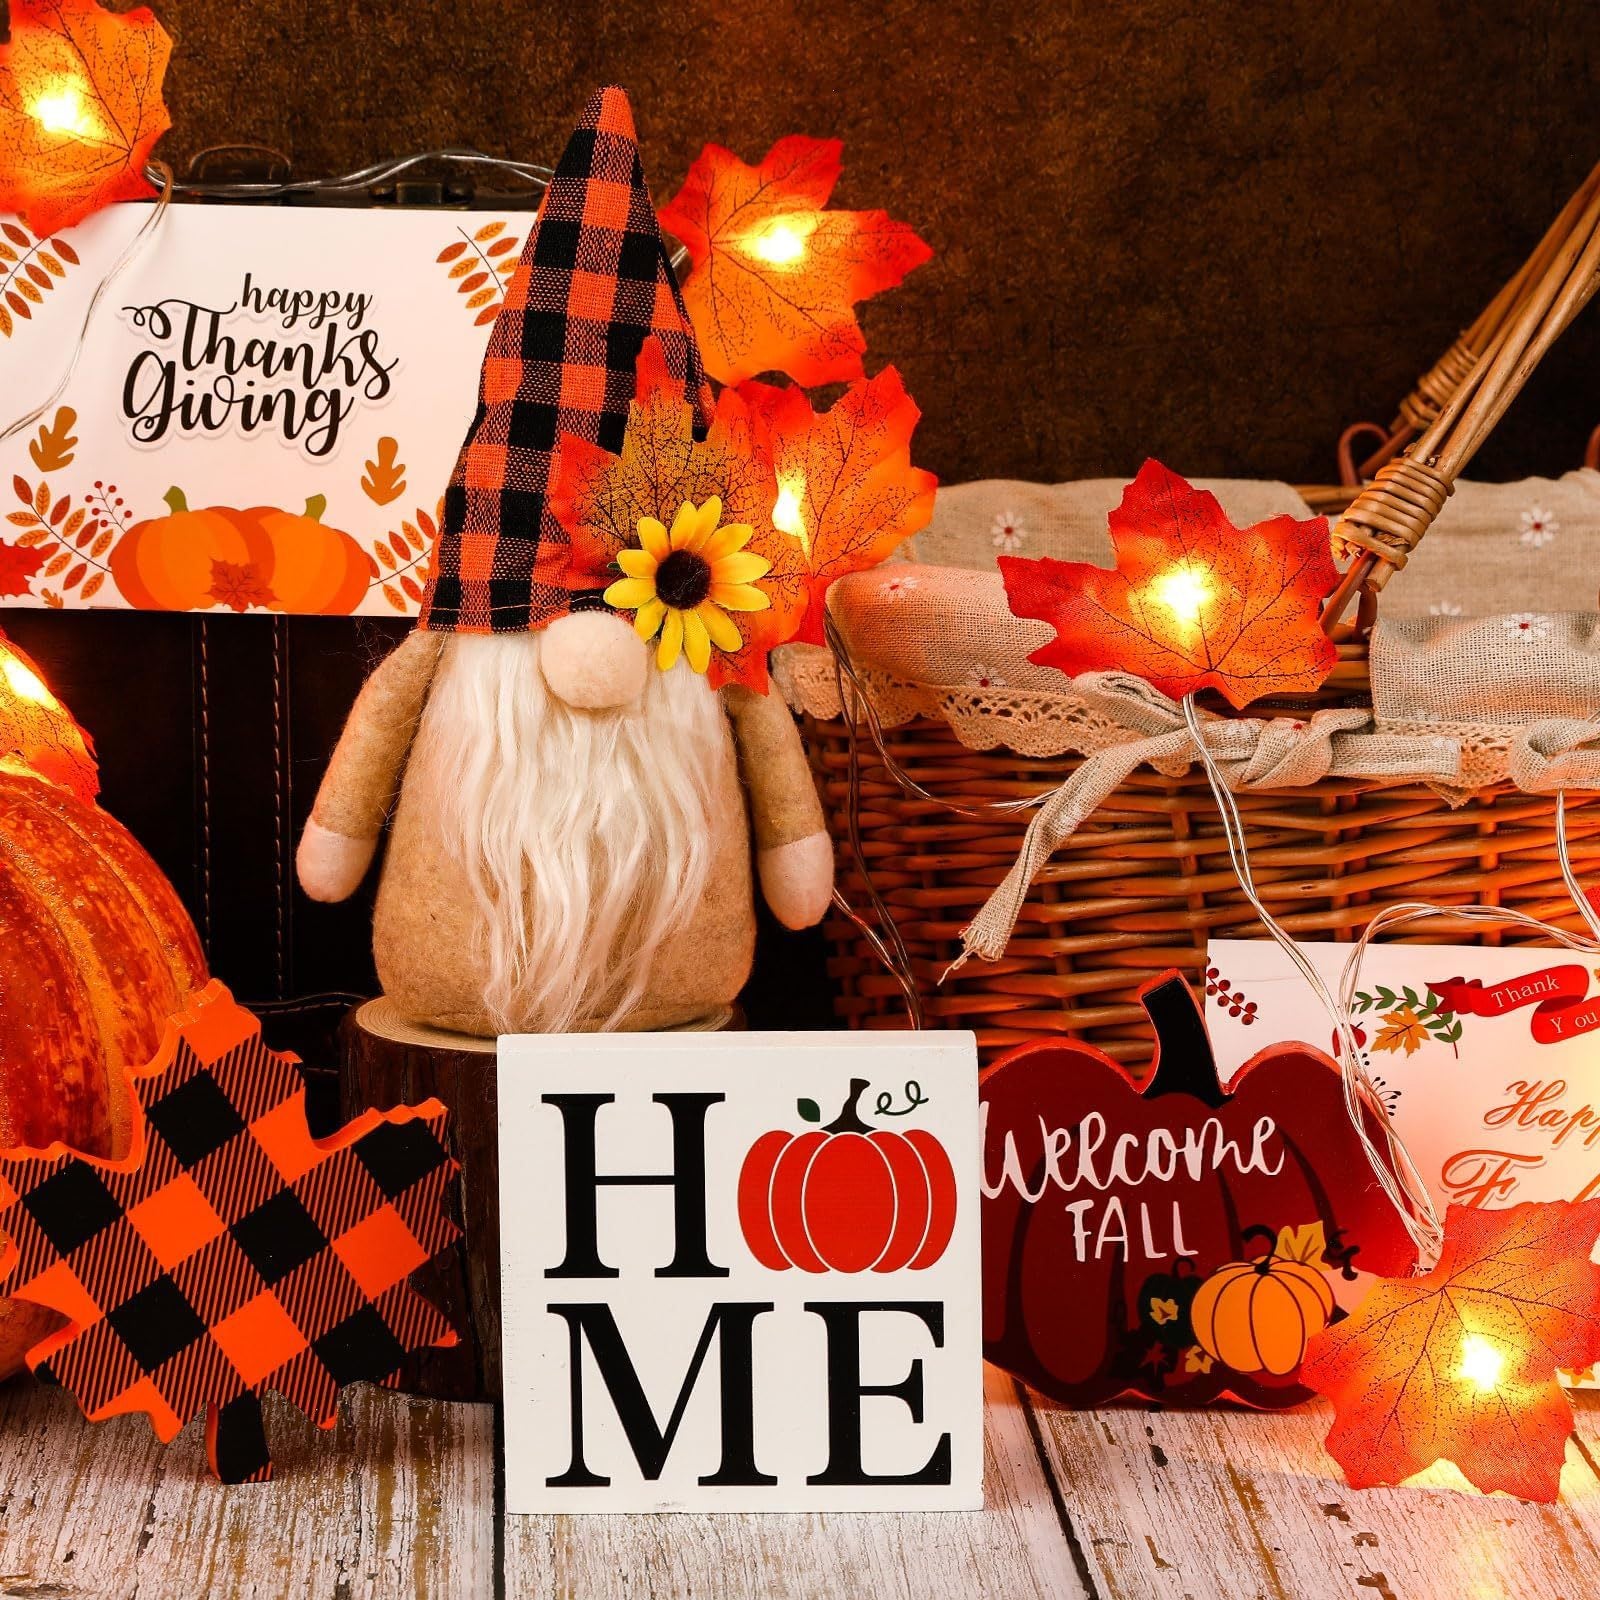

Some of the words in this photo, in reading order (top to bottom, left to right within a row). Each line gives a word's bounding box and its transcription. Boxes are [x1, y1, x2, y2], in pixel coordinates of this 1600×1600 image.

[241, 272, 374, 329] happy
[121, 298, 400, 401] Thanks
[123, 350, 354, 457] Giving
[1491, 974, 1560, 1008] Thank
[979, 1100, 1285, 1204] Welcome
[1064, 1196, 1199, 1263] FALL
